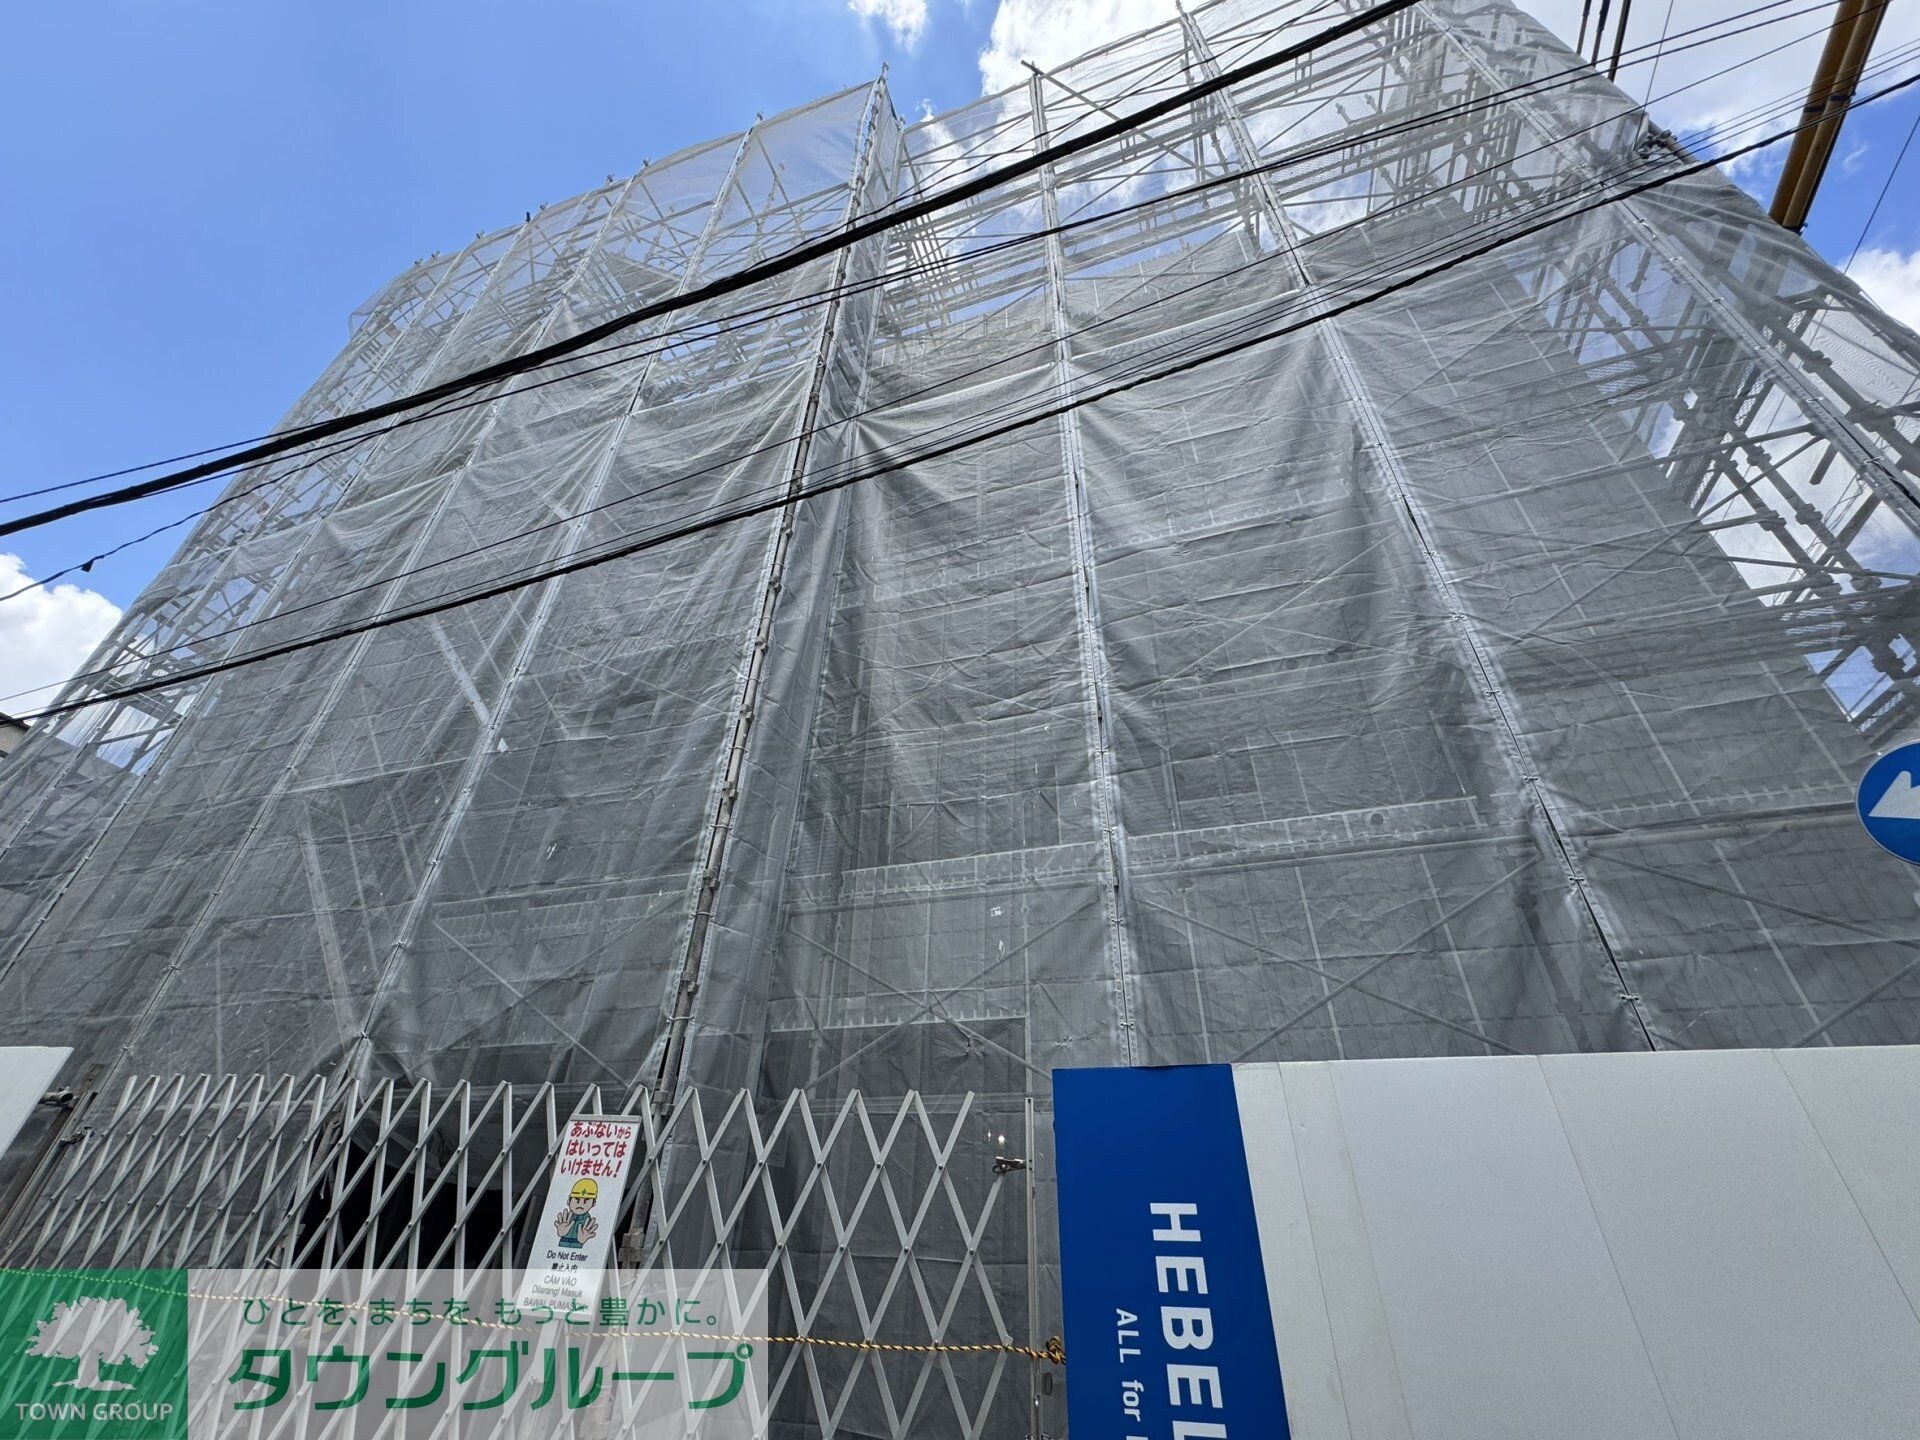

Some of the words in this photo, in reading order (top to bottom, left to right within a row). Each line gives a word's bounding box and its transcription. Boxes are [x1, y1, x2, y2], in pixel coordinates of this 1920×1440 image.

[571, 1121, 632, 1139] あぶないから
[566, 1140, 627, 1158] はいっては
[547, 1250, 557, 1260] Do
[558, 1251, 570, 1261] Not
[570, 1252, 588, 1262] Enter
[561, 1288, 583, 1298] Masuk
[1116, 1308, 1141, 1364] ALL
[1121, 1380, 1145, 1422] for
